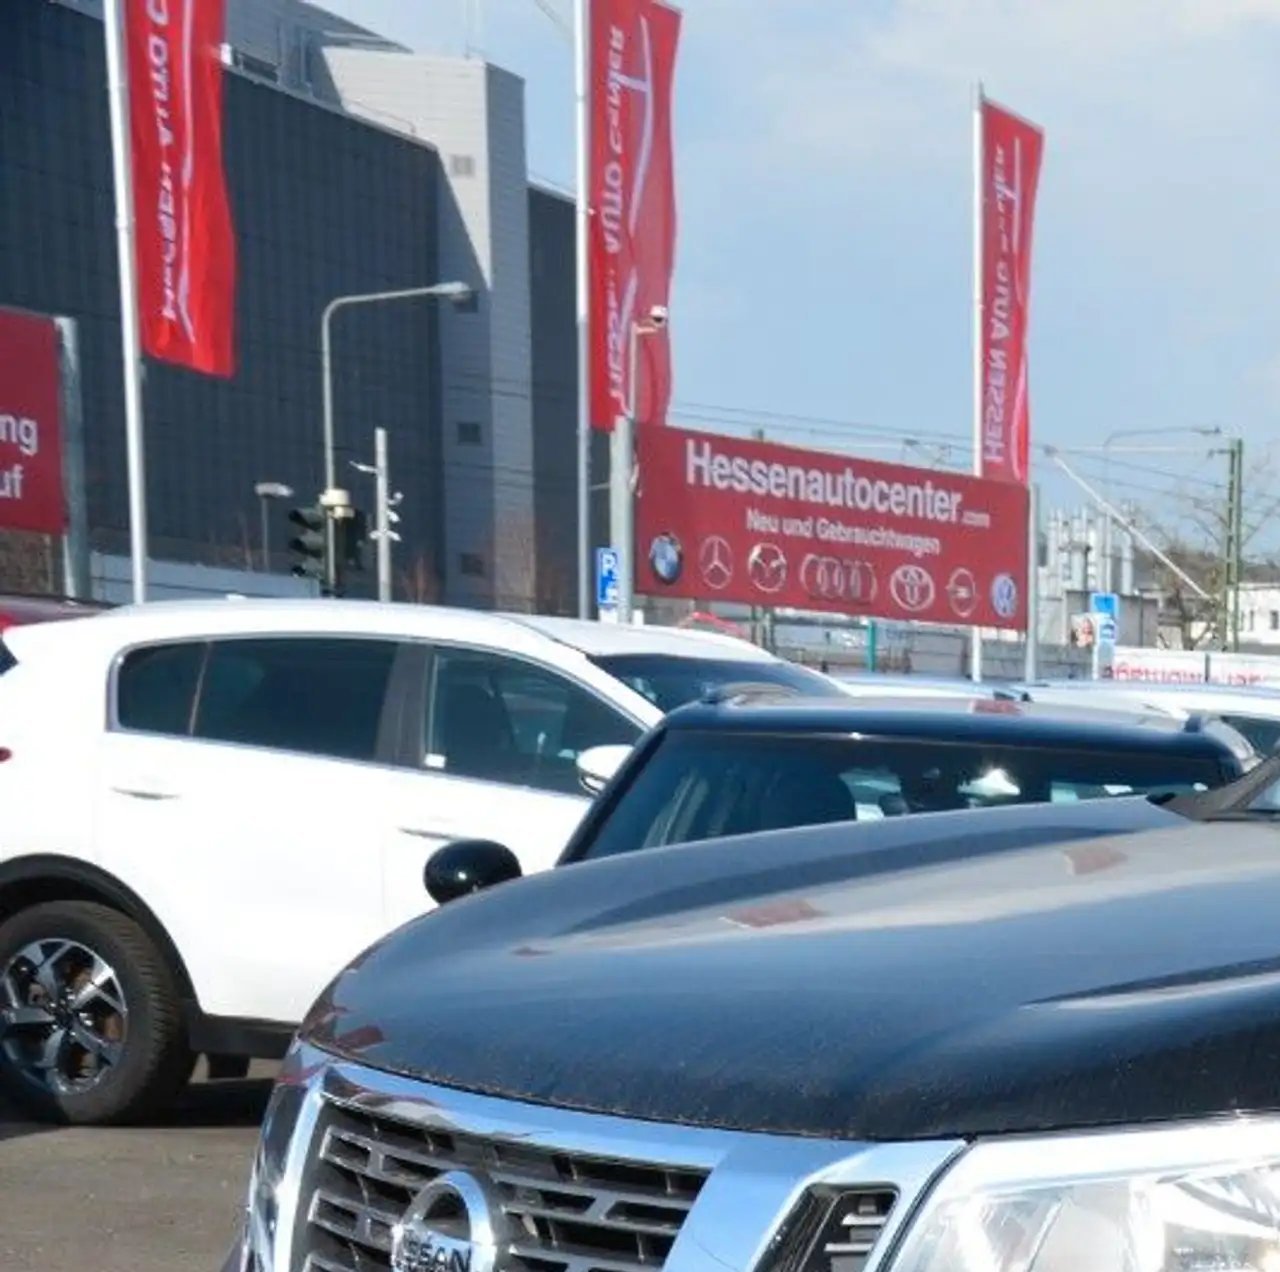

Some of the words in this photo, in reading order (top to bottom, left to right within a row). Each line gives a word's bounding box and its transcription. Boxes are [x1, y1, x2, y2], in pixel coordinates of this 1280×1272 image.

[746, 508, 779, 533] Neu
[782, 515, 812, 538] und
[816, 518, 941, 558] Gebrauchtwagen
